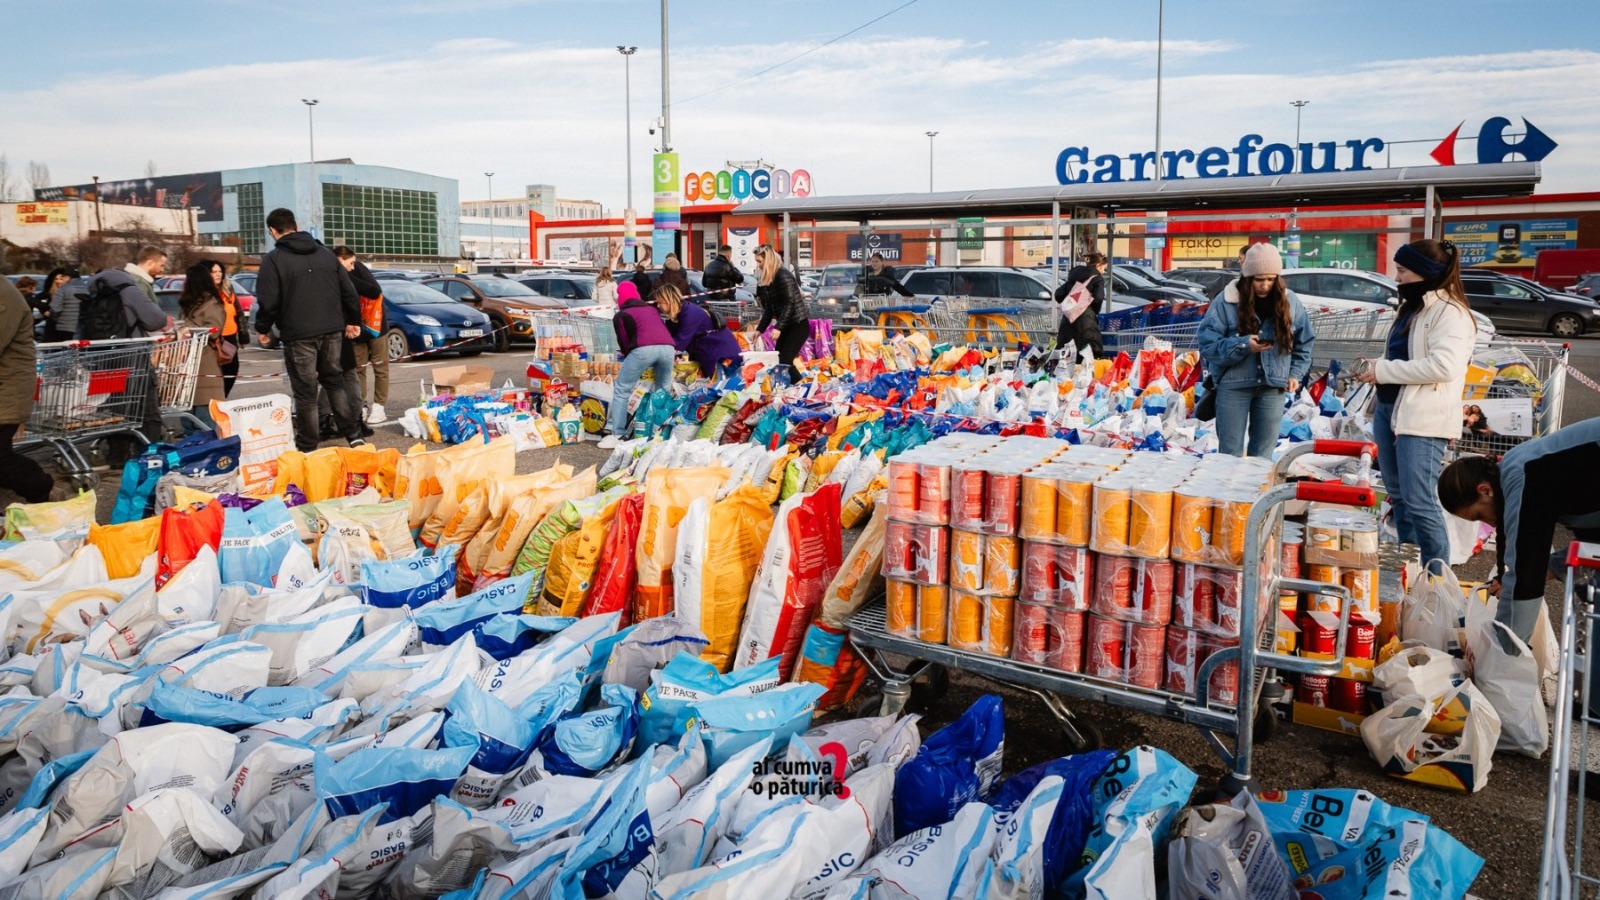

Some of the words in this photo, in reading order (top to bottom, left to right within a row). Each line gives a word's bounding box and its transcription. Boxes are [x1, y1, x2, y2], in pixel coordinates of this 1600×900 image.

[1056, 134, 1384, 185] Carrefour
[657, 159, 672, 183] 3
[270, 524, 294, 538] VALUE
[673, 687, 697, 699] PACK
[462, 783, 493, 793] BASIC
[370, 842, 405, 860] BASIC
